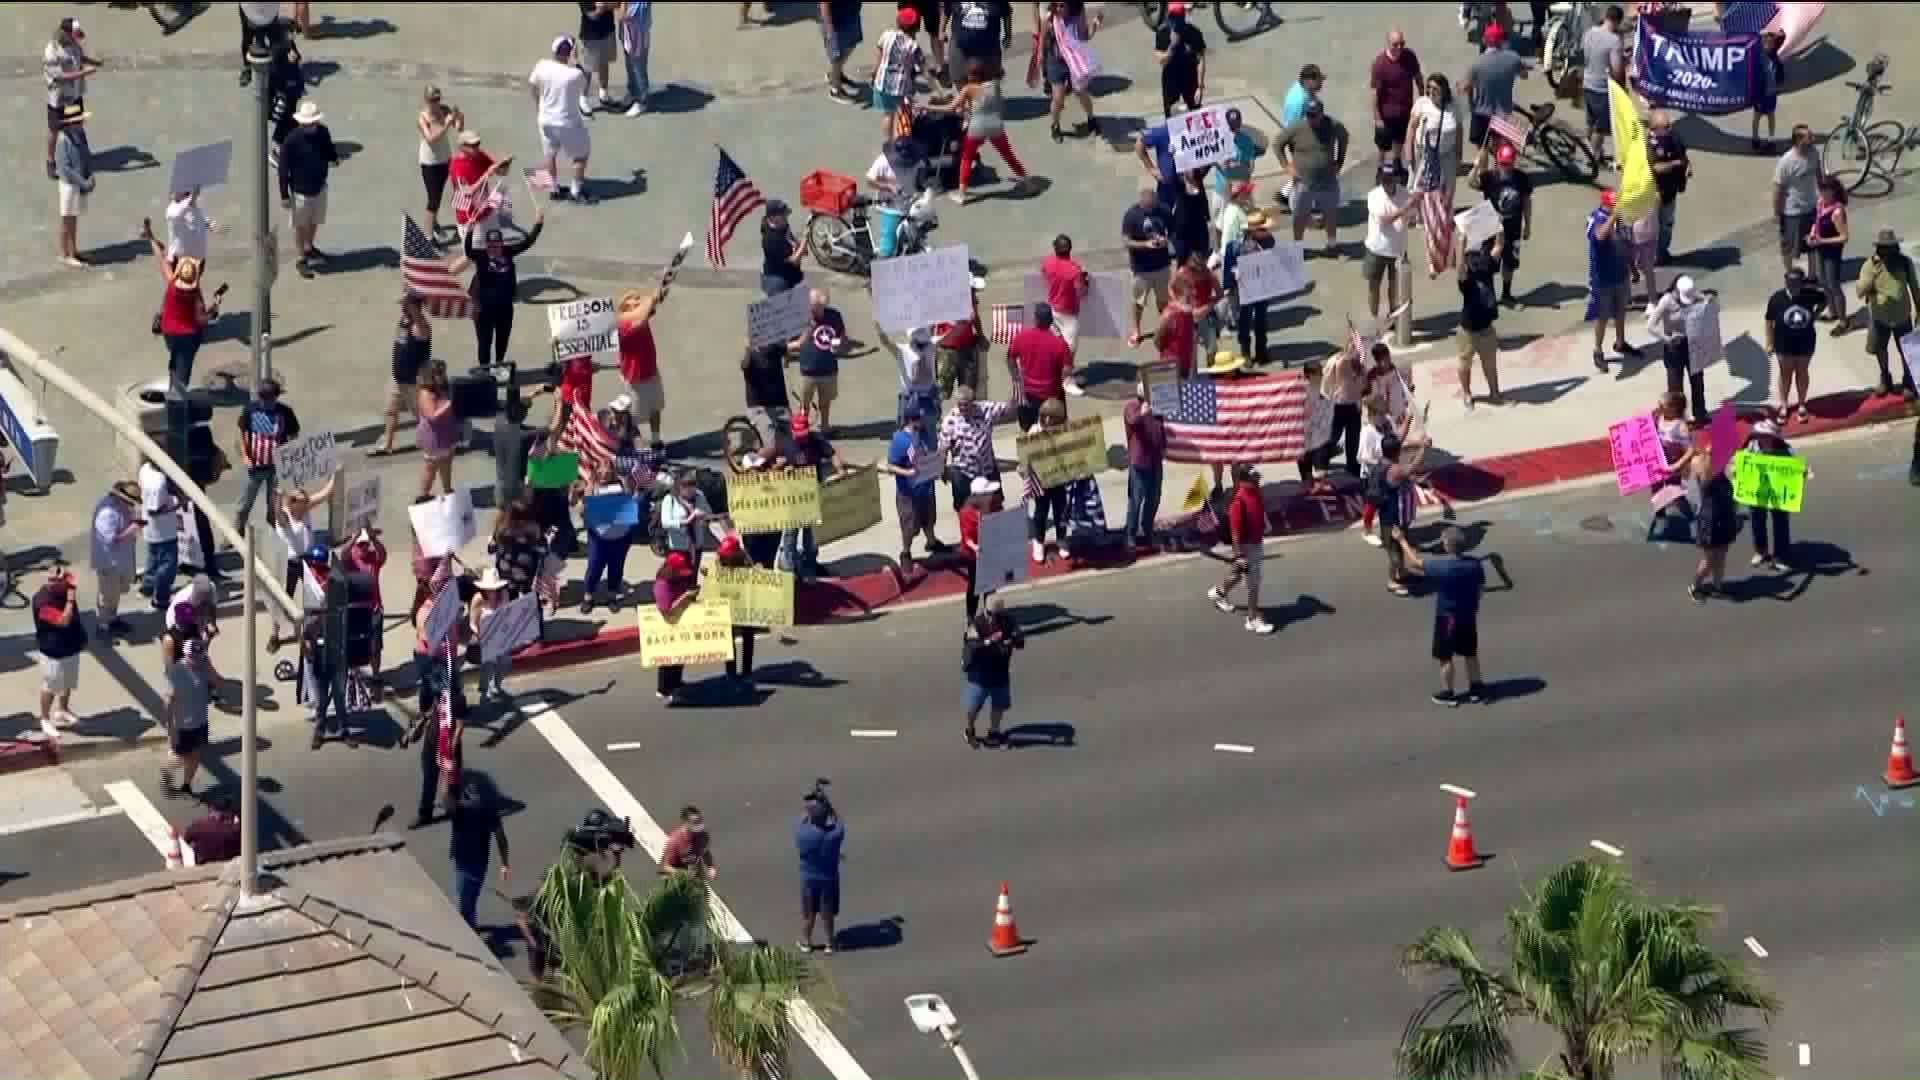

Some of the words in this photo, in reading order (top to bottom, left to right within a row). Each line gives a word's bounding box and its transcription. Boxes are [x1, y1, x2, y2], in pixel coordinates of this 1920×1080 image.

[1650, 33, 1746, 71] TRUMP
[550, 298, 616, 320] FREEDOM
[552, 332, 617, 354] ESSENTIAL
[646, 631, 676, 647] BACK
[694, 629, 729, 642] WORK
